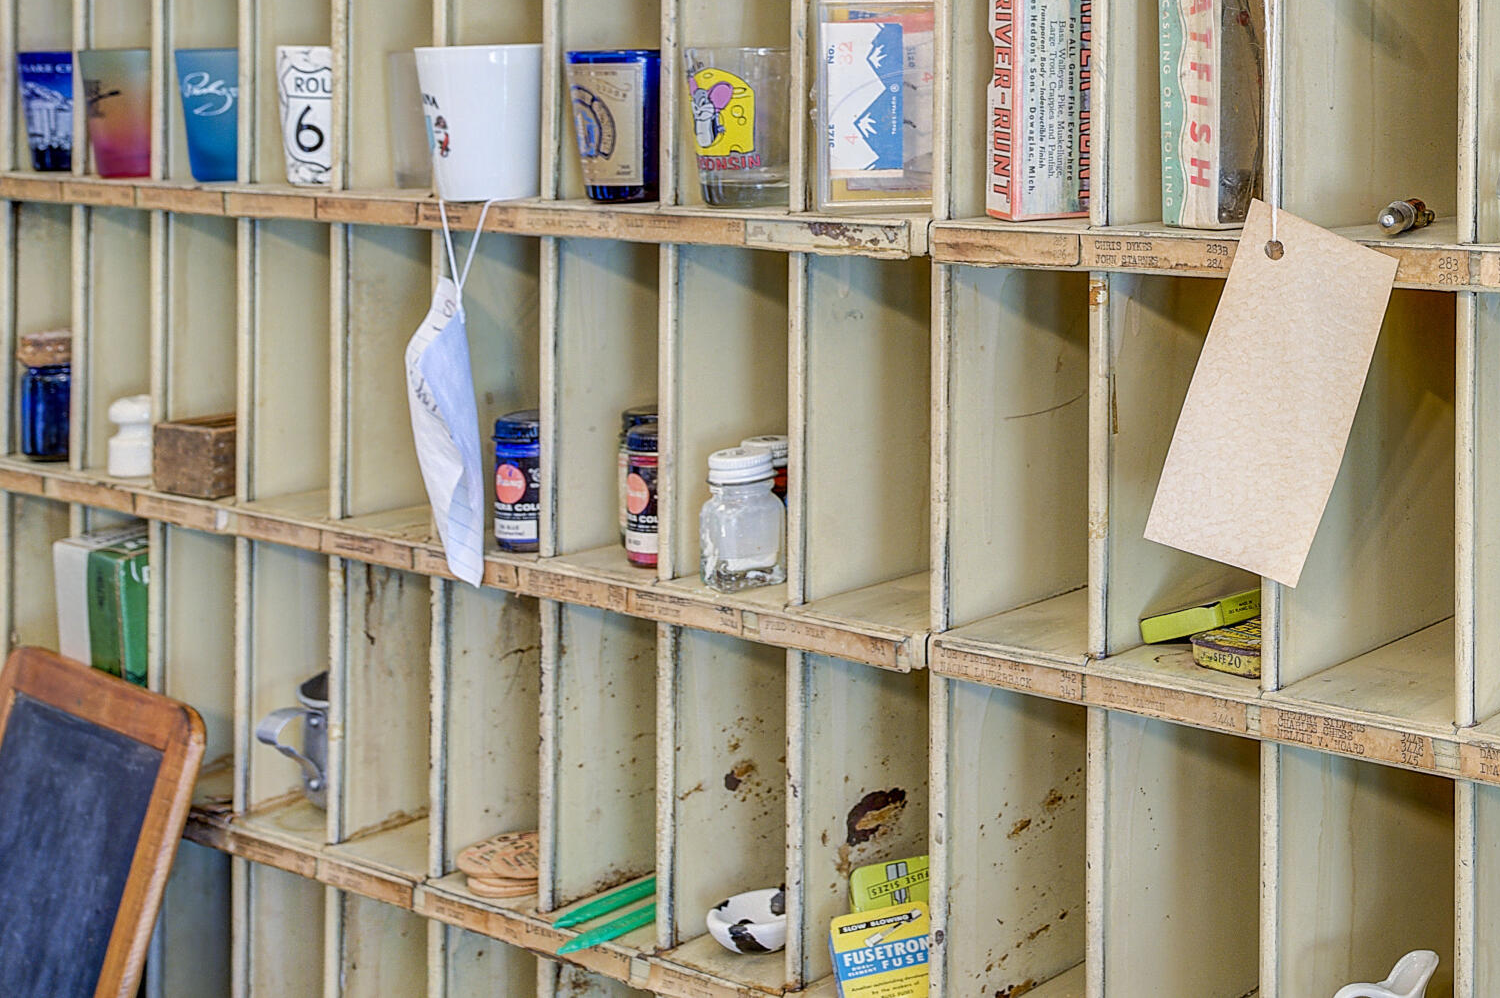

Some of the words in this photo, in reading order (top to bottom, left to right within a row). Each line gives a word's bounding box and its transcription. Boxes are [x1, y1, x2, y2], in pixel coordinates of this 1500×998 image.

[1030, 15, 1038, 63] Heddon's
[1162, 0, 1171, 75] CASTING
[839, 41, 853, 65] 32
[1163, 88, 1171, 108] OR
[844, 134, 858, 145] 4
[1066, 122, 1075, 181] Everywhere
[1163, 122, 1173, 207] TROLLING
[1094, 240, 1121, 251] CHRIS
[1126, 241, 1153, 251] DYKES
[1438, 257, 1459, 271] 283
[1228, 652, 1242, 670] 20
[1334, 738, 1366, 755] HOARD
[1400, 753, 1419, 766] 345
[871, 882, 900, 896] SIZES
[842, 922, 867, 933] SLOW
[870, 914, 909, 927] BLOWING
[843, 936, 929, 967] FUSETRON
[882, 952, 925, 970] FUSE
